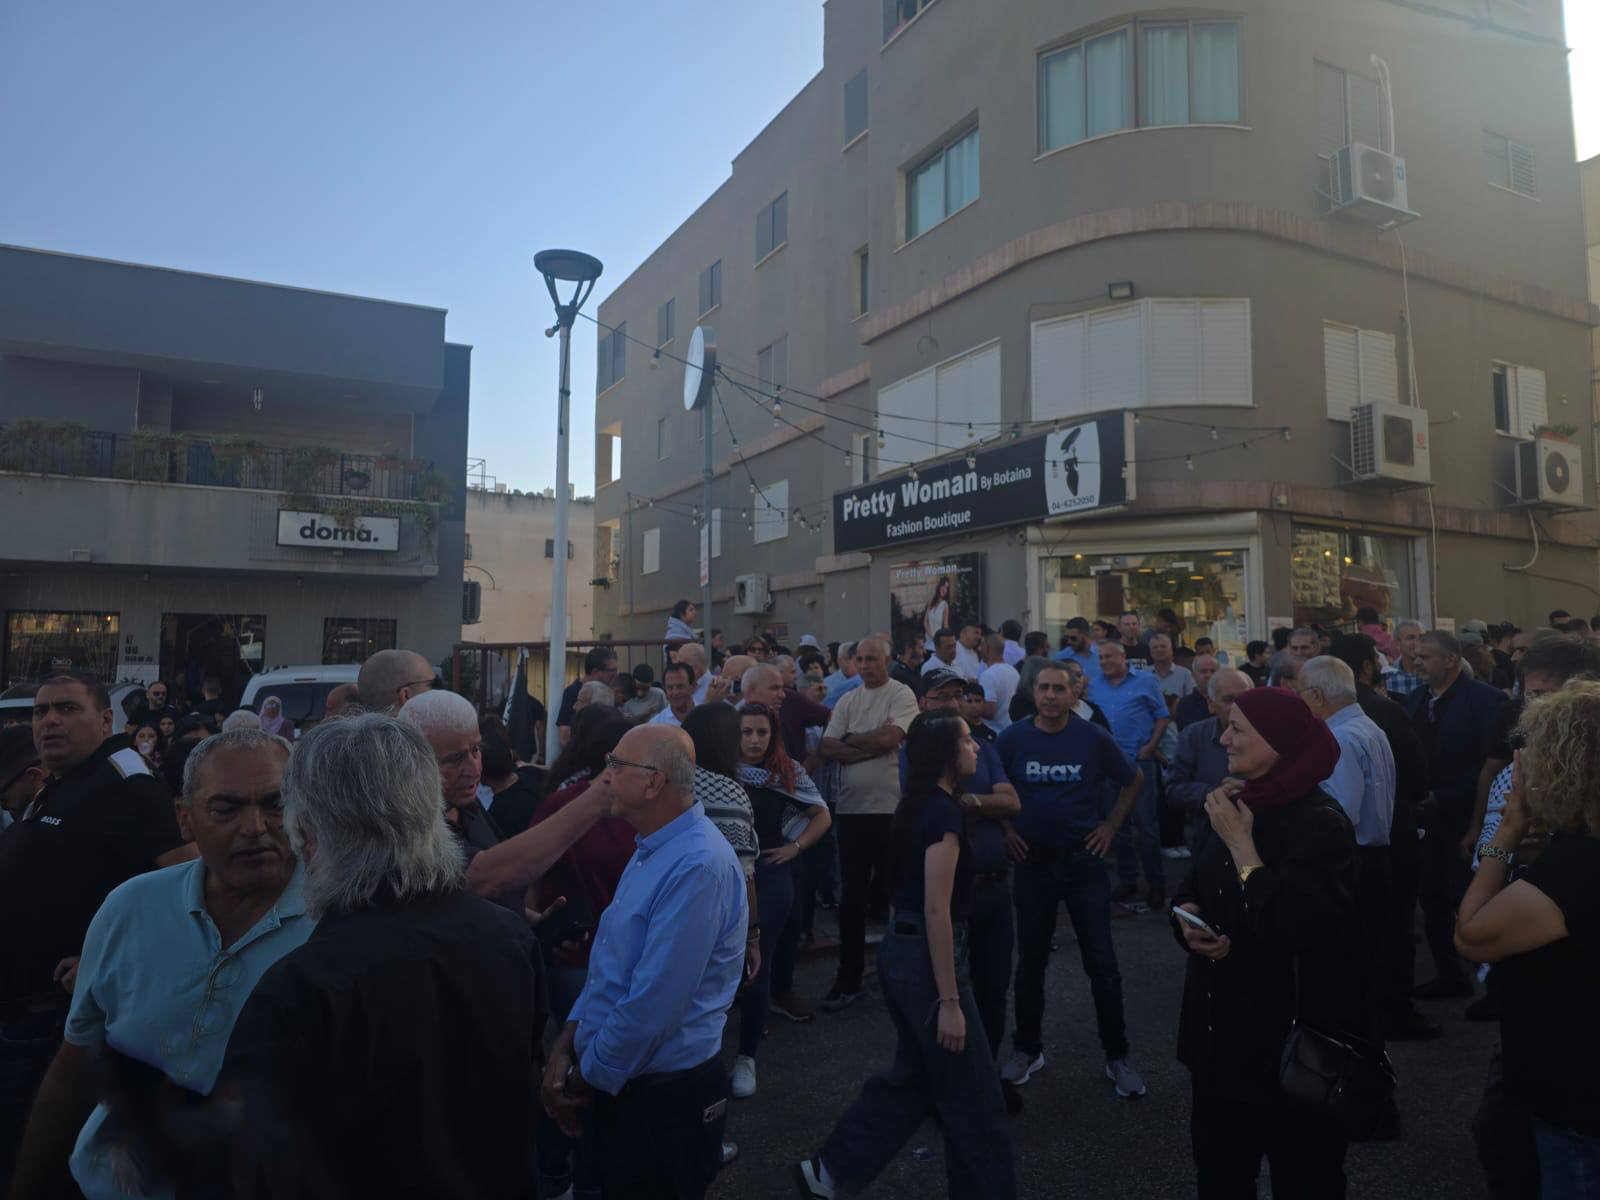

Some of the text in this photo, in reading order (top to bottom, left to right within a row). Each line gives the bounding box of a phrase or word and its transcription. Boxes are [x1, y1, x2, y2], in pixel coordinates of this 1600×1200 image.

[843, 467, 1032, 522] Pretty Woman By Botaina
[299, 518, 379, 543] doma.
[886, 509, 972, 538] Fashion Boutique
[1025, 760, 1082, 782] Brax
